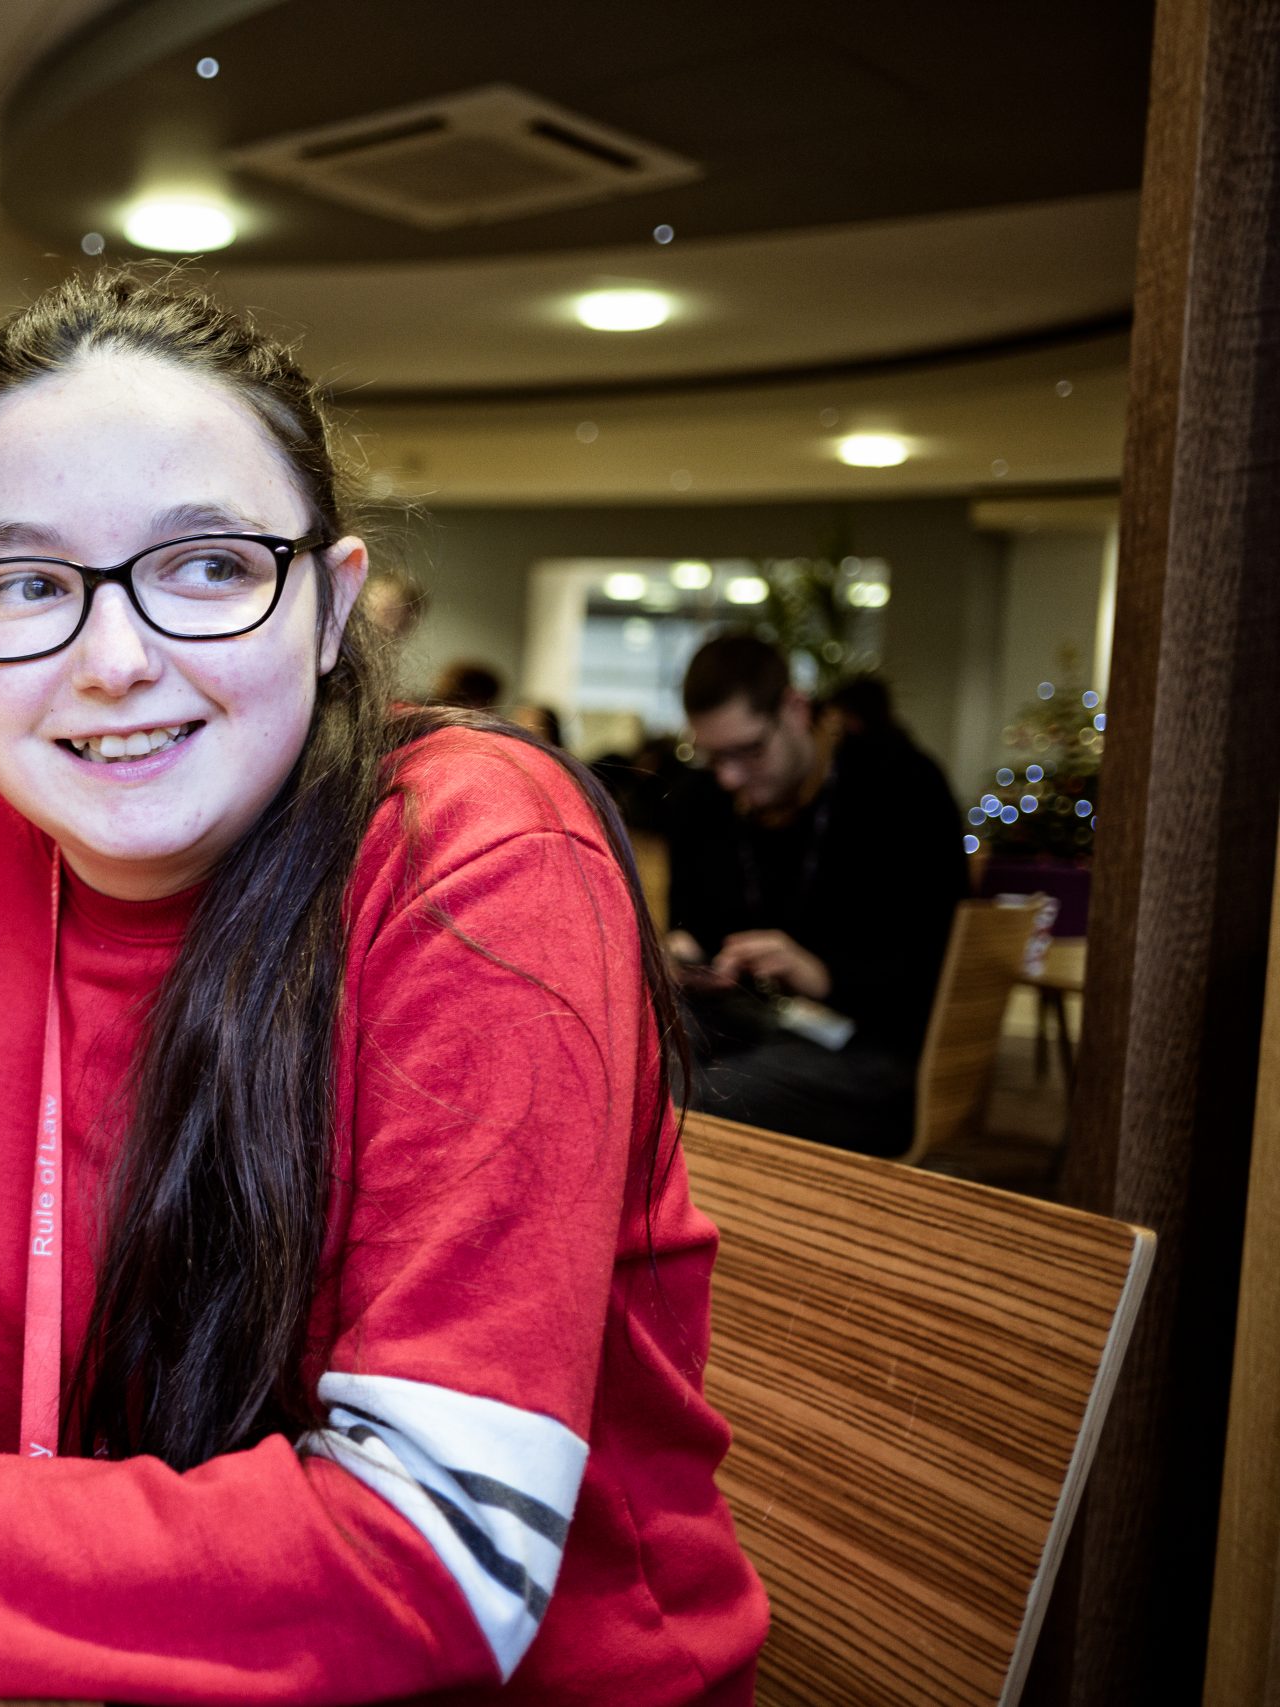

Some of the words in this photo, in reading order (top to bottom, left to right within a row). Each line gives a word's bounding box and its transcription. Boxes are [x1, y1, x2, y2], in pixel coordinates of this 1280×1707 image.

[40, 1095, 57, 1152] Law
[37, 1156, 56, 1185] of
[32, 1191, 55, 1256] Rule
